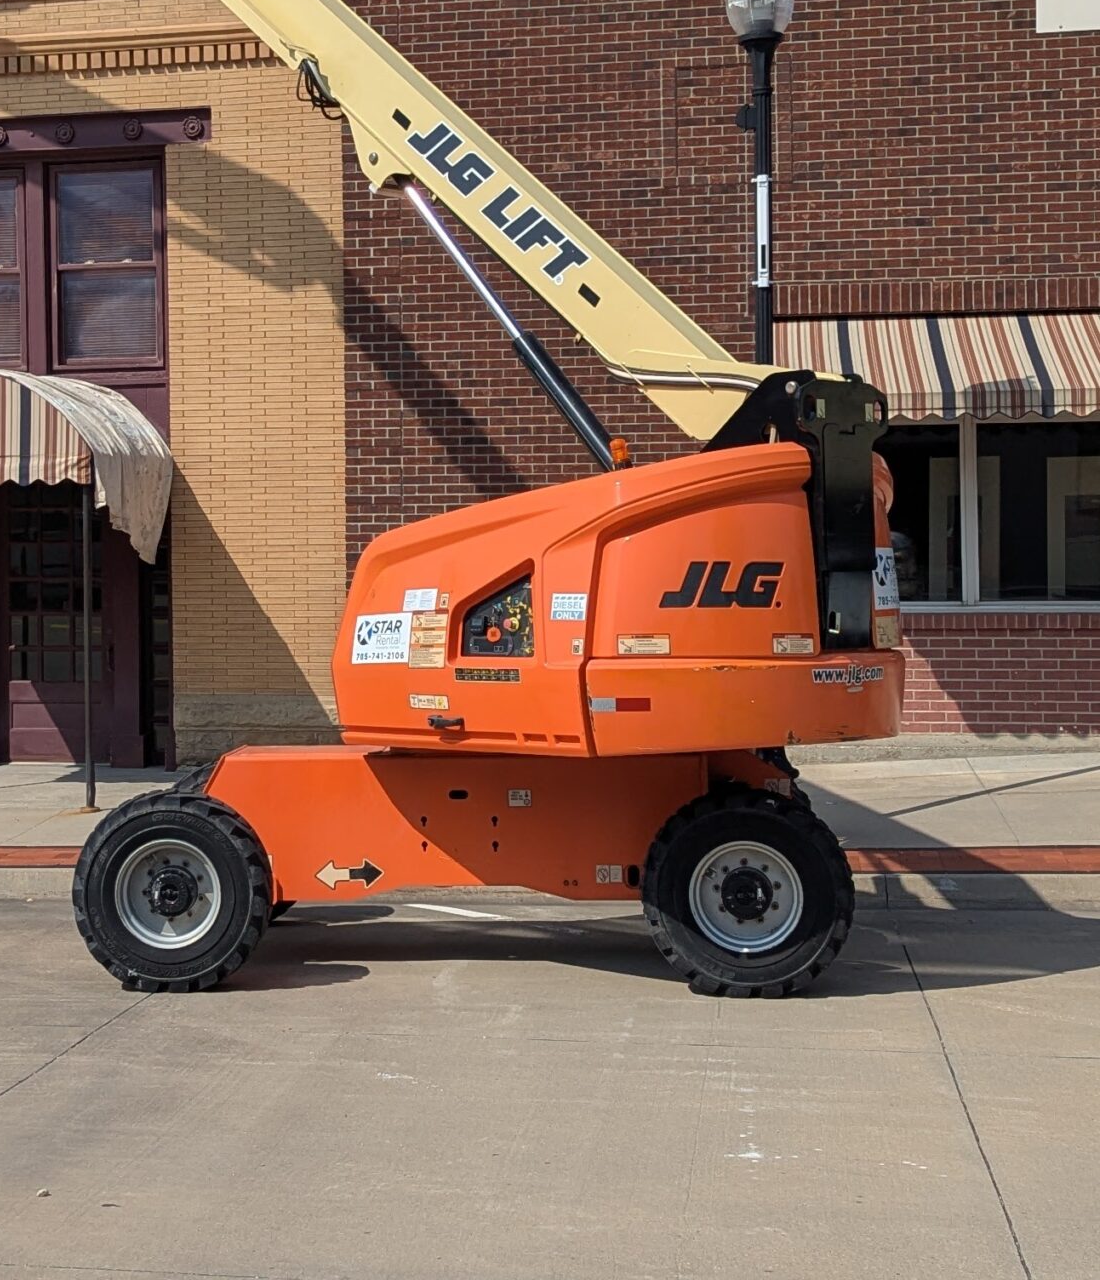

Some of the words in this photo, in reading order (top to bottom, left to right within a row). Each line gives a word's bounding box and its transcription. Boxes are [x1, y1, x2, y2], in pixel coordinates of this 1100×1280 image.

[407, 123, 496, 196] JLG
[480, 187, 590, 279] LIFT
[659, 561, 784, 608] JLG
[553, 601, 584, 609] DIESEL
[556, 611, 580, 619] ONLY
[373, 619, 402, 634] STAR
[375, 635, 400, 646] Rental
[812, 665, 884, 684] www.jlg.com
